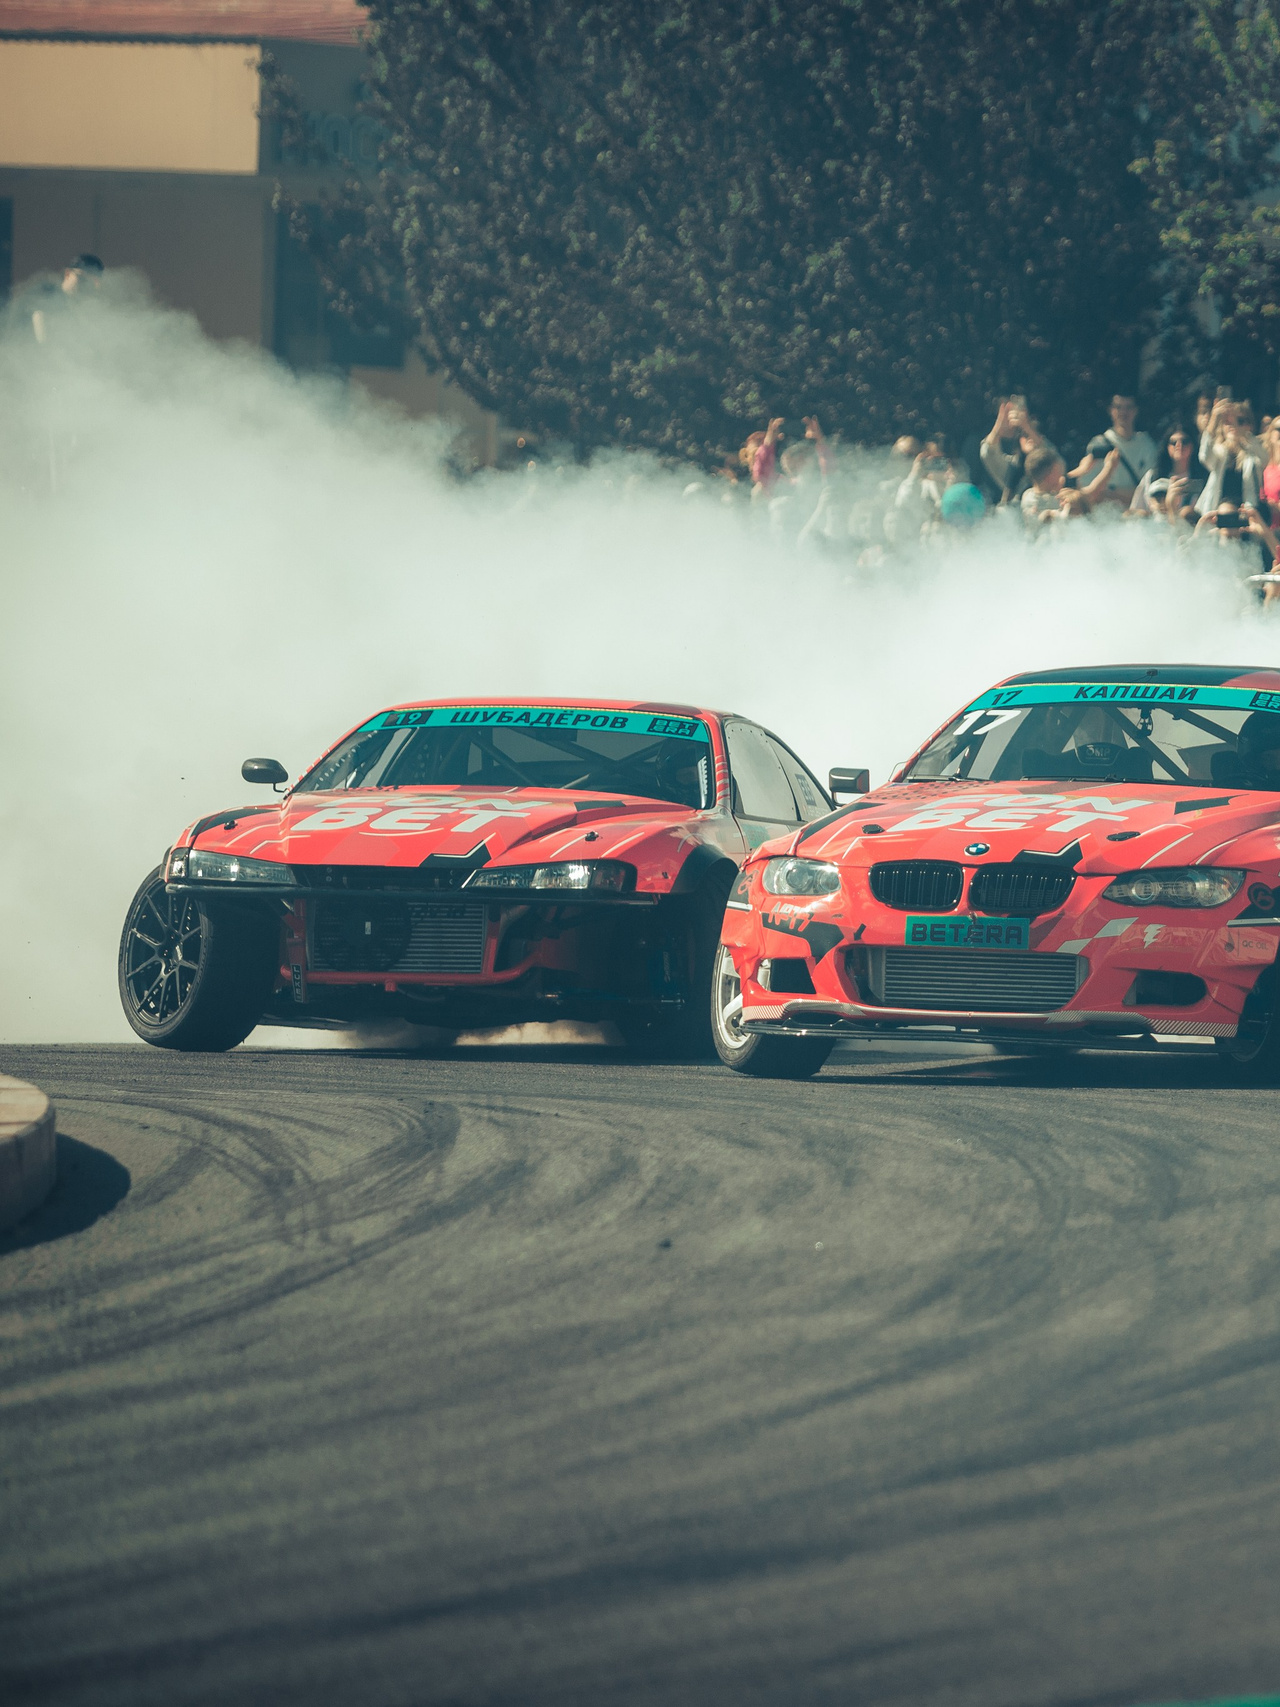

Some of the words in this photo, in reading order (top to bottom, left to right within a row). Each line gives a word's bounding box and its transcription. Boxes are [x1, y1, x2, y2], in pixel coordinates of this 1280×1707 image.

[991, 689, 1023, 706] 17
[394, 712, 423, 726] 19
[449, 710, 629, 729] ШУБАДЁРОВ
[952, 709, 1022, 736] 17
[314, 796, 553, 811] FON
[913, 793, 1155, 813] FON
[290, 807, 531, 833] BET
[886, 807, 1130, 833] BET
